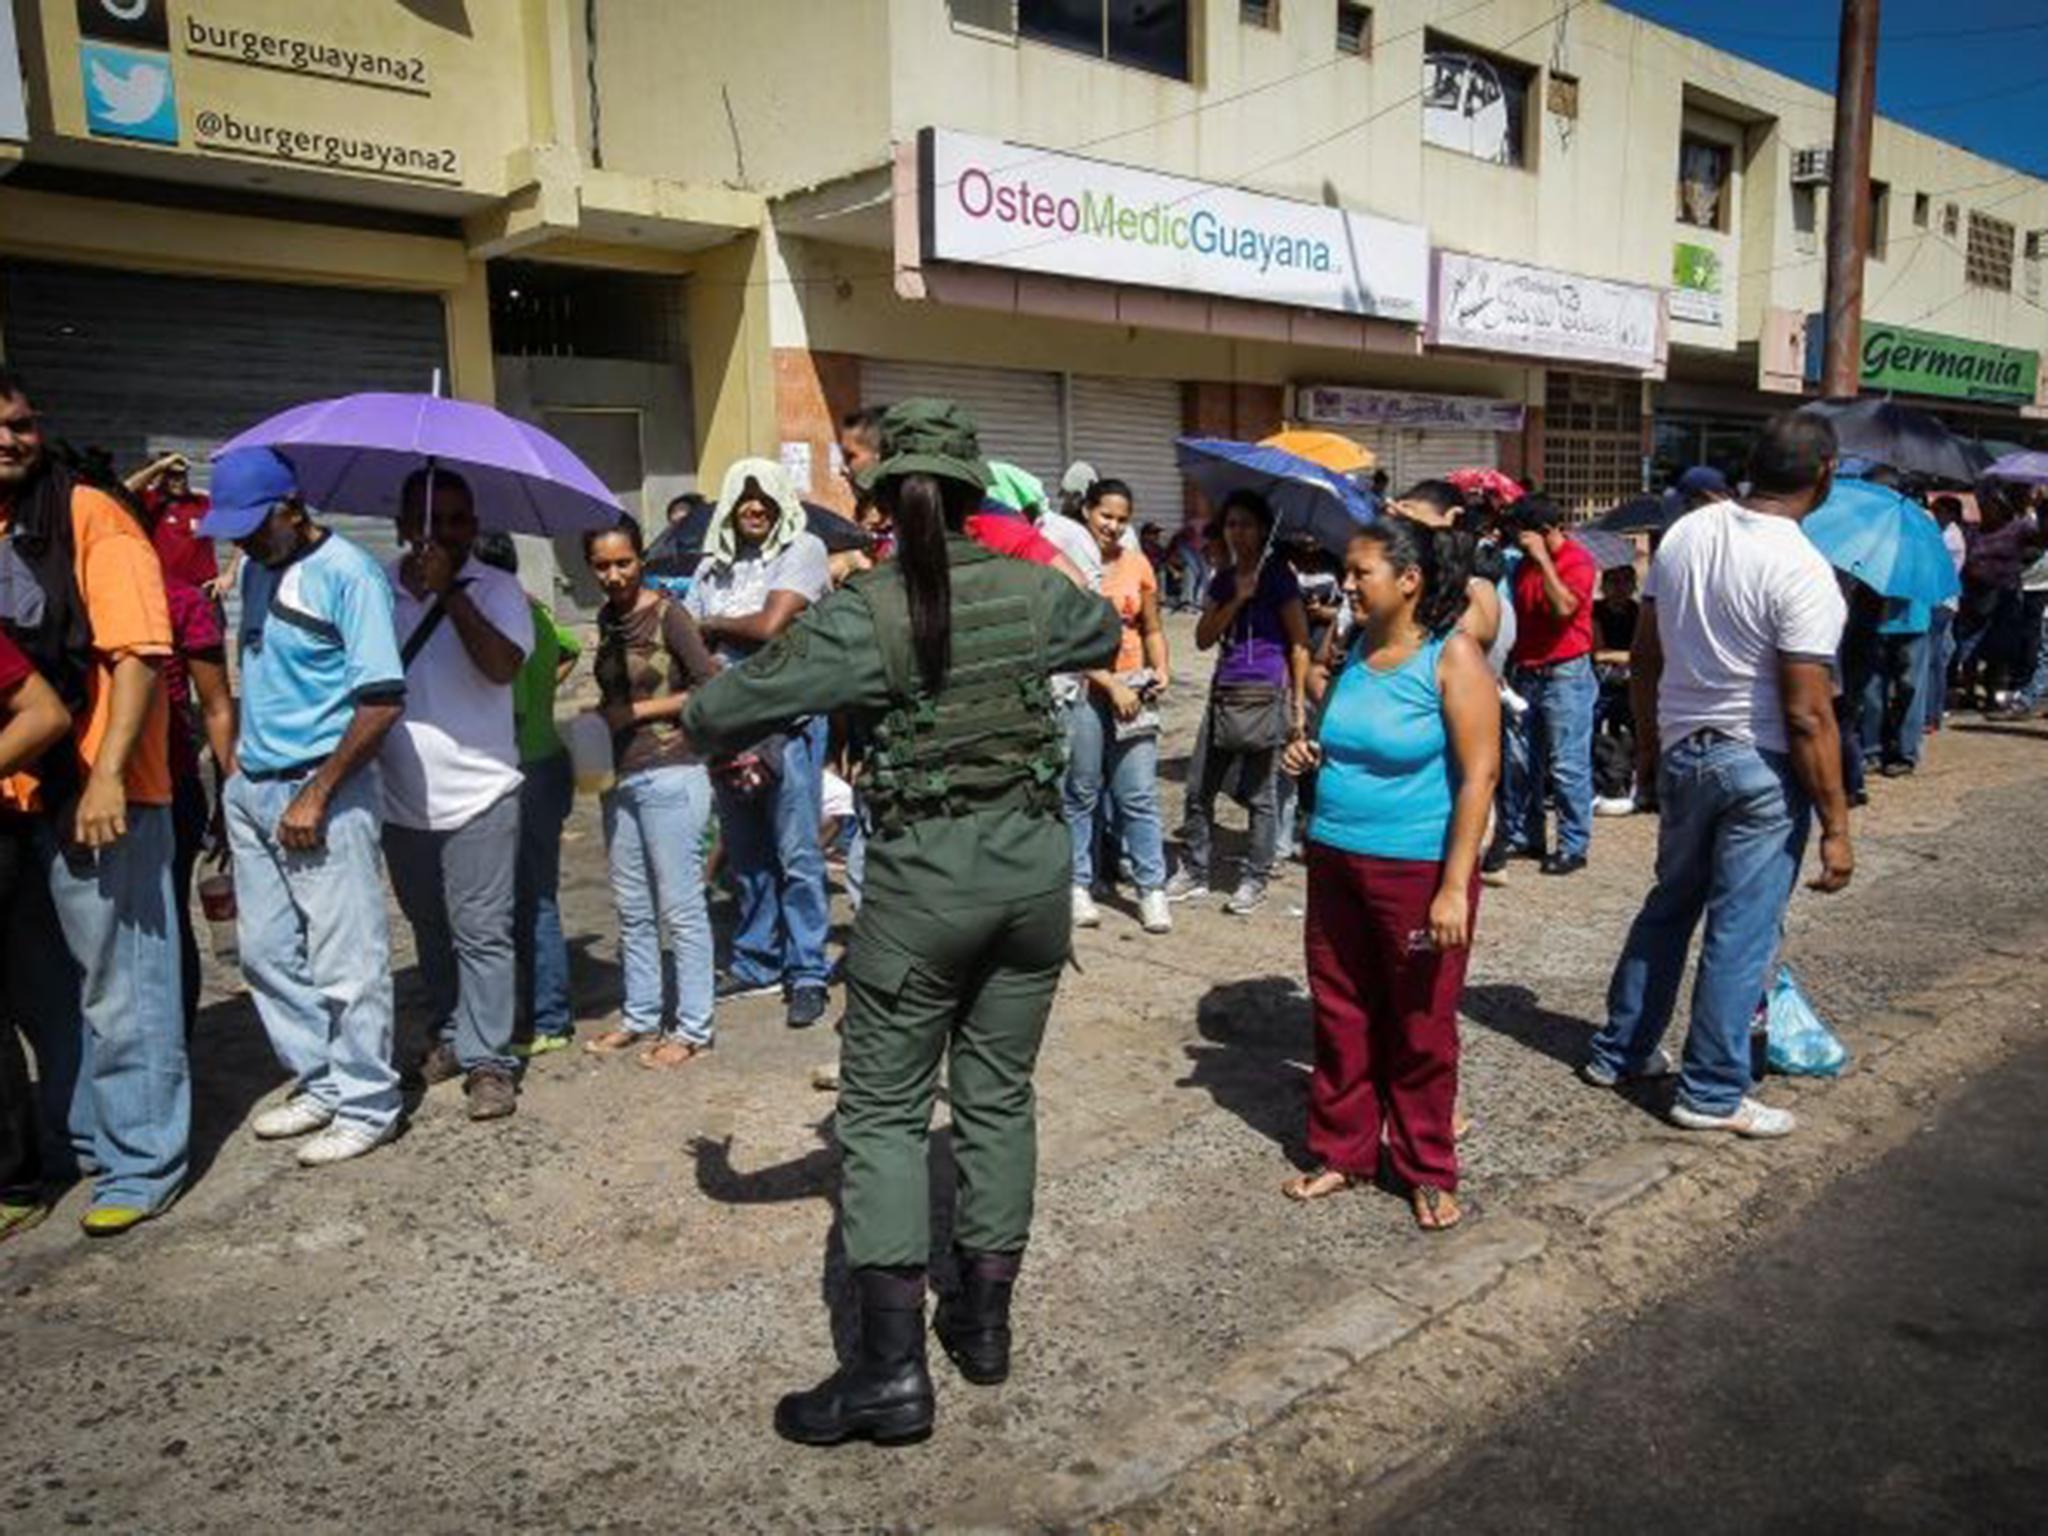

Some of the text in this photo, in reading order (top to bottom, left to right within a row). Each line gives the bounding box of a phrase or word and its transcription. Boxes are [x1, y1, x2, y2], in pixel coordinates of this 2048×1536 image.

[187, 16, 427, 84] burgerguayana2
[197, 110, 457, 172] @burgerguayana2
[1862, 331, 2022, 387] Germania
